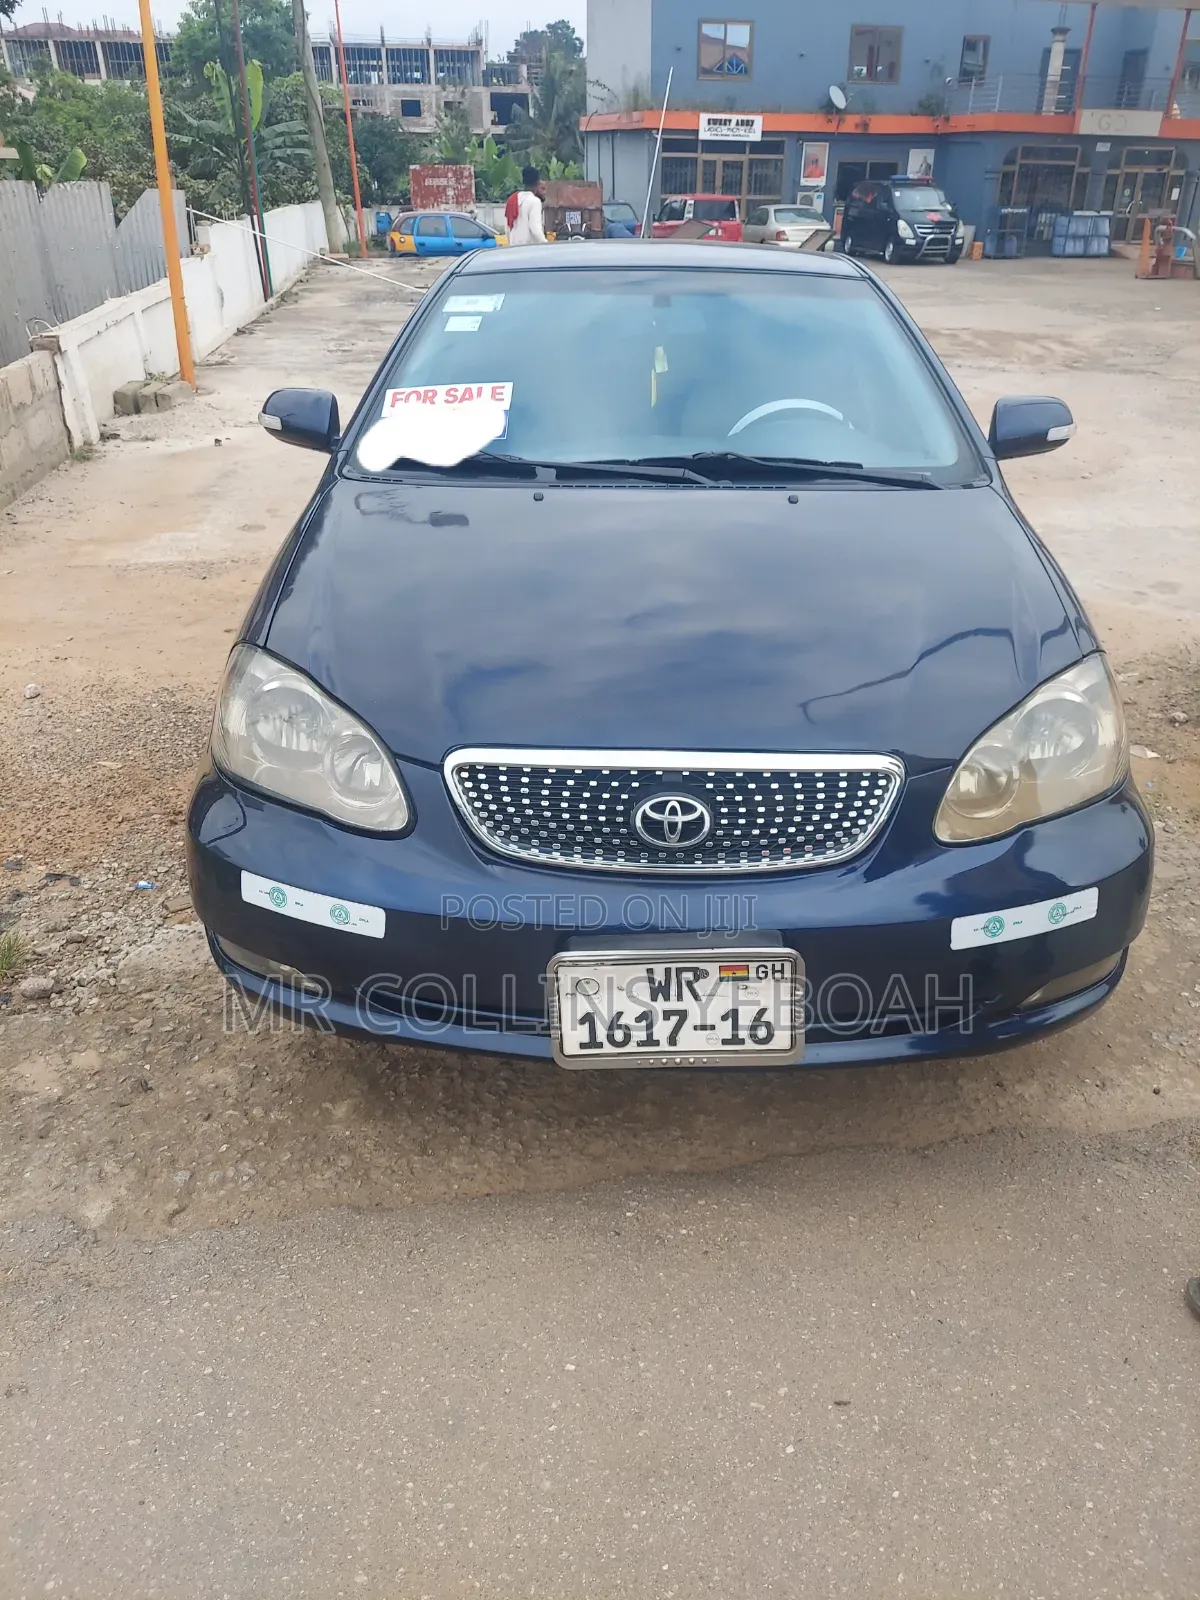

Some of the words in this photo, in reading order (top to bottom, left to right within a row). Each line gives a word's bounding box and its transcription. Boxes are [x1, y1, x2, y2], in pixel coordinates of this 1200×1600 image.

[390, 389, 438, 408] FOR
[646, 966, 703, 1002] WR
[755, 962, 785, 981] GH
[578, 1007, 775, 1049] 1617-16
